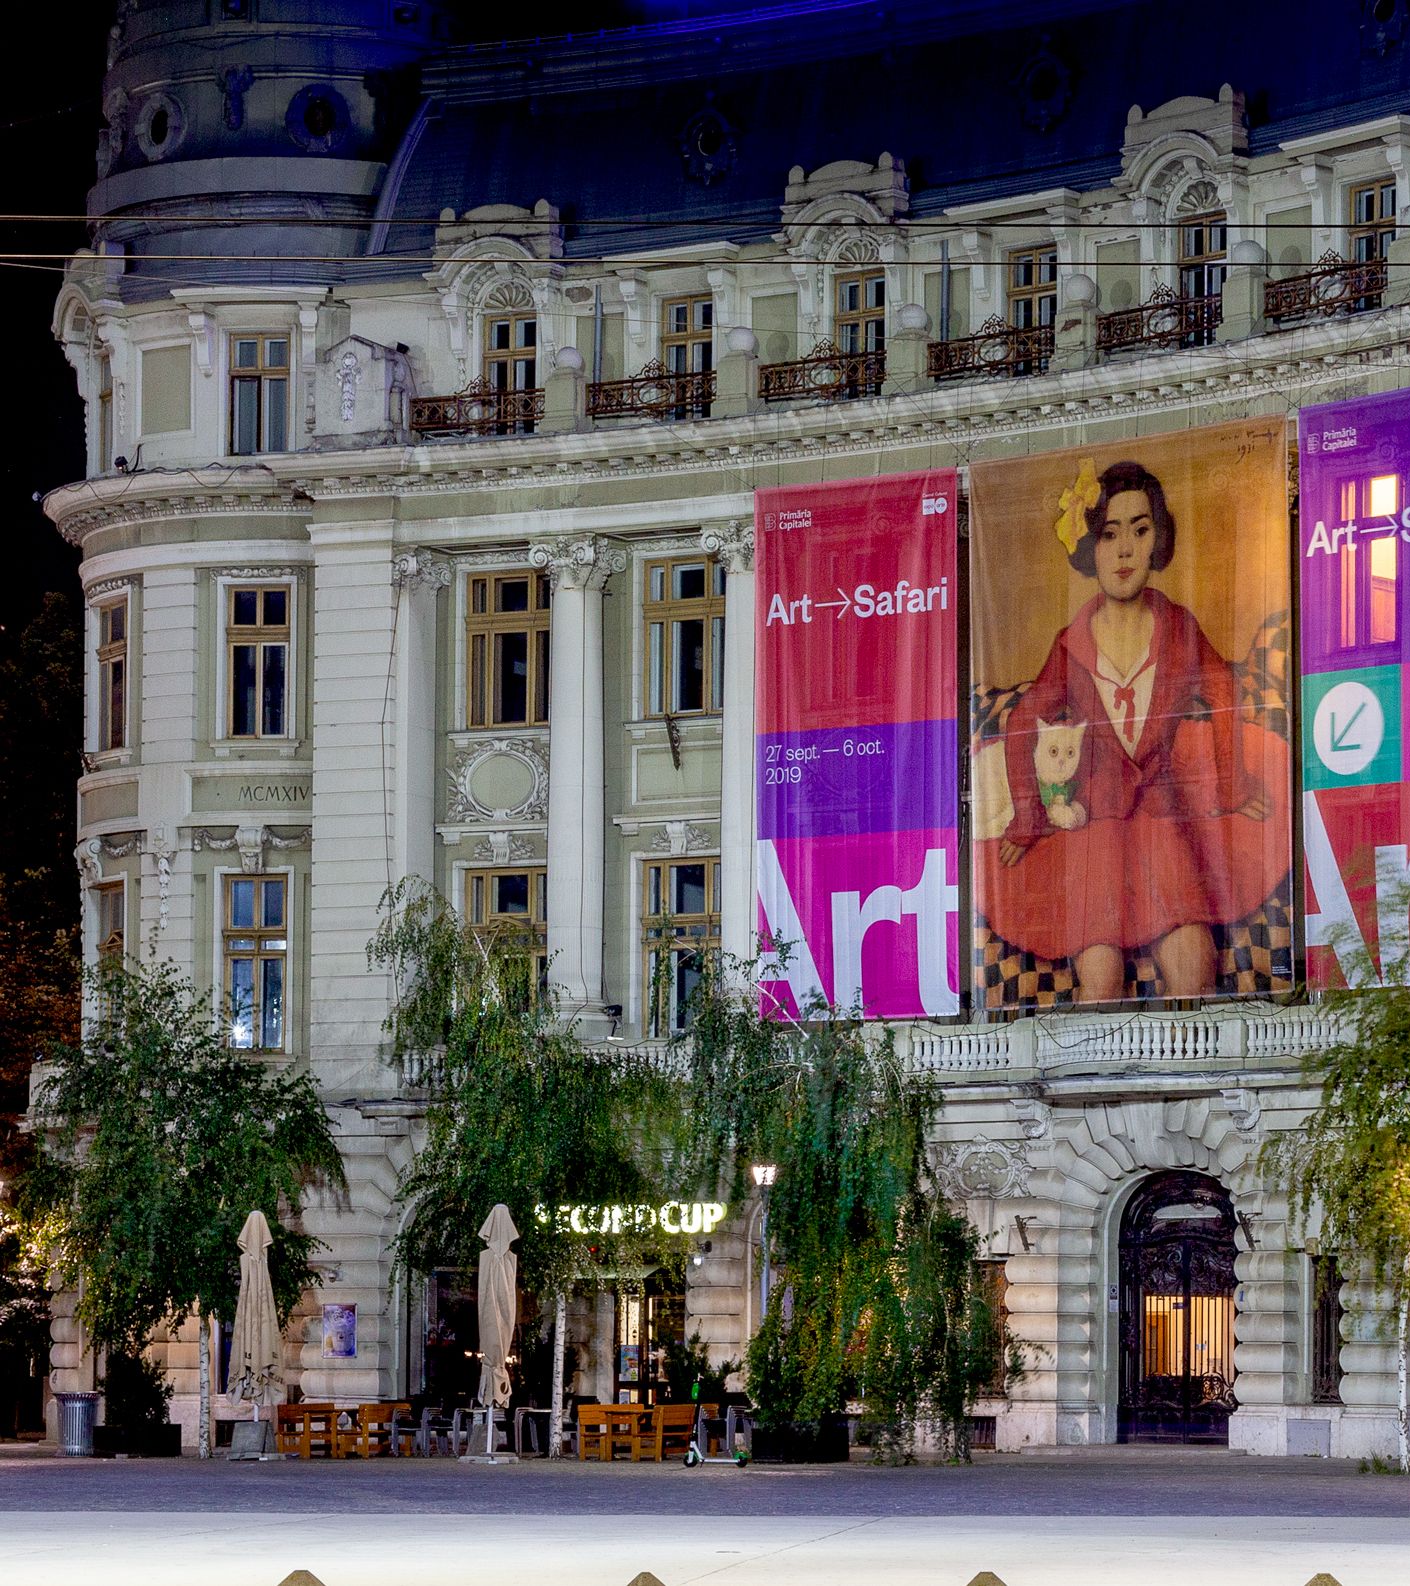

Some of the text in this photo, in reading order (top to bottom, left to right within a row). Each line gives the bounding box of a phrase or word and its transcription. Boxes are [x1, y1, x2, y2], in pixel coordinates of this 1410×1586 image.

[1322, 436, 1357, 452] Capitalei
[779, 518, 812, 531] Capitalei
[1306, 520, 1357, 557] Art
[766, 577, 948, 627] Art Safari
[766, 745, 782, 762] 27
[786, 744, 821, 764] sept.
[843, 739, 854, 757] 6
[857, 739, 885, 756] oct.
[766, 766, 801, 785] 2019
[238, 786, 310, 802] MCMXIV
[757, 839, 960, 1021] Art
[659, 1200, 728, 1234] CUP
